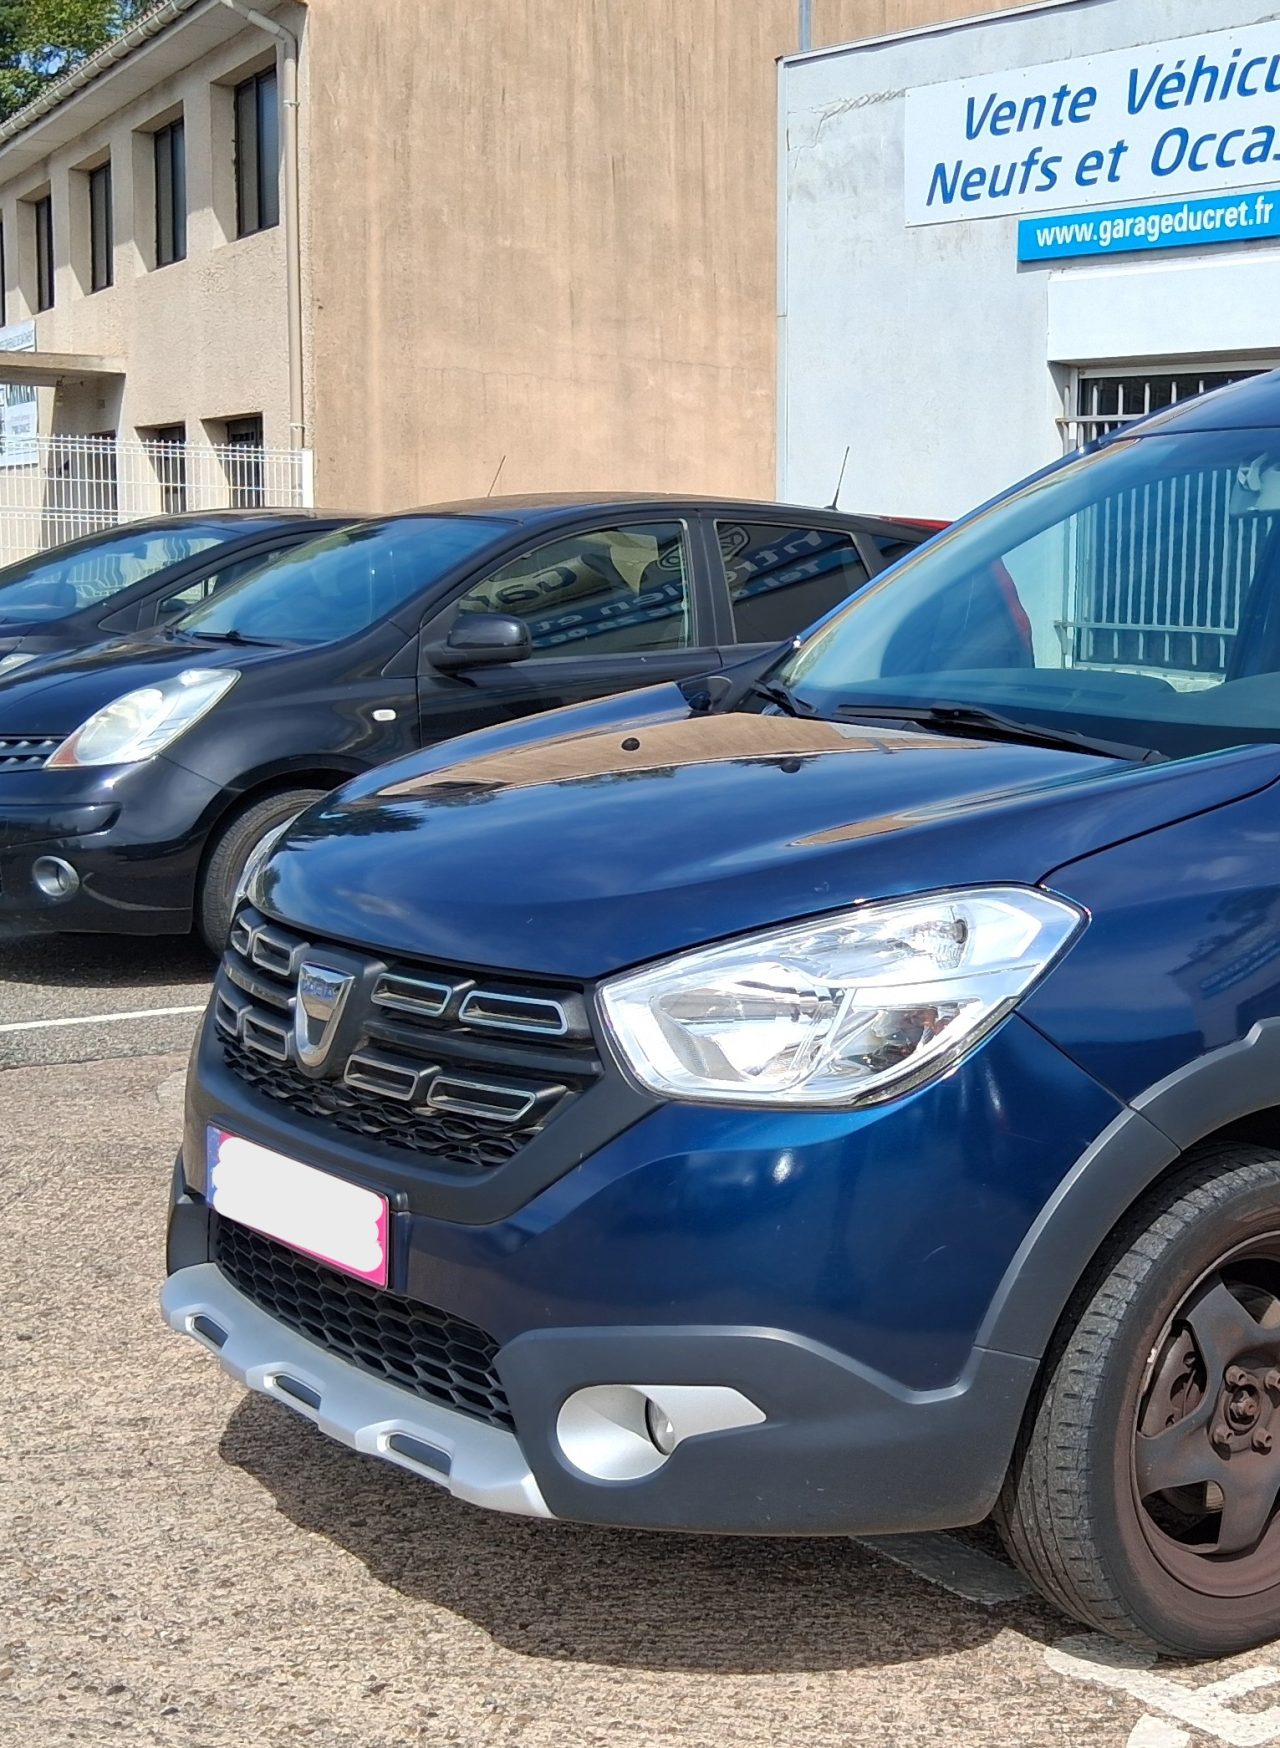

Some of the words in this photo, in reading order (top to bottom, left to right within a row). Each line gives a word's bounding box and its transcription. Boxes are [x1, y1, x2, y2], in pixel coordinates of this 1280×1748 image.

[965, 83, 1097, 141] Vente
[926, 147, 1062, 206] Neufs
[1075, 140, 1129, 187] et
[1036, 199, 1273, 247] www.garageducret.fr
